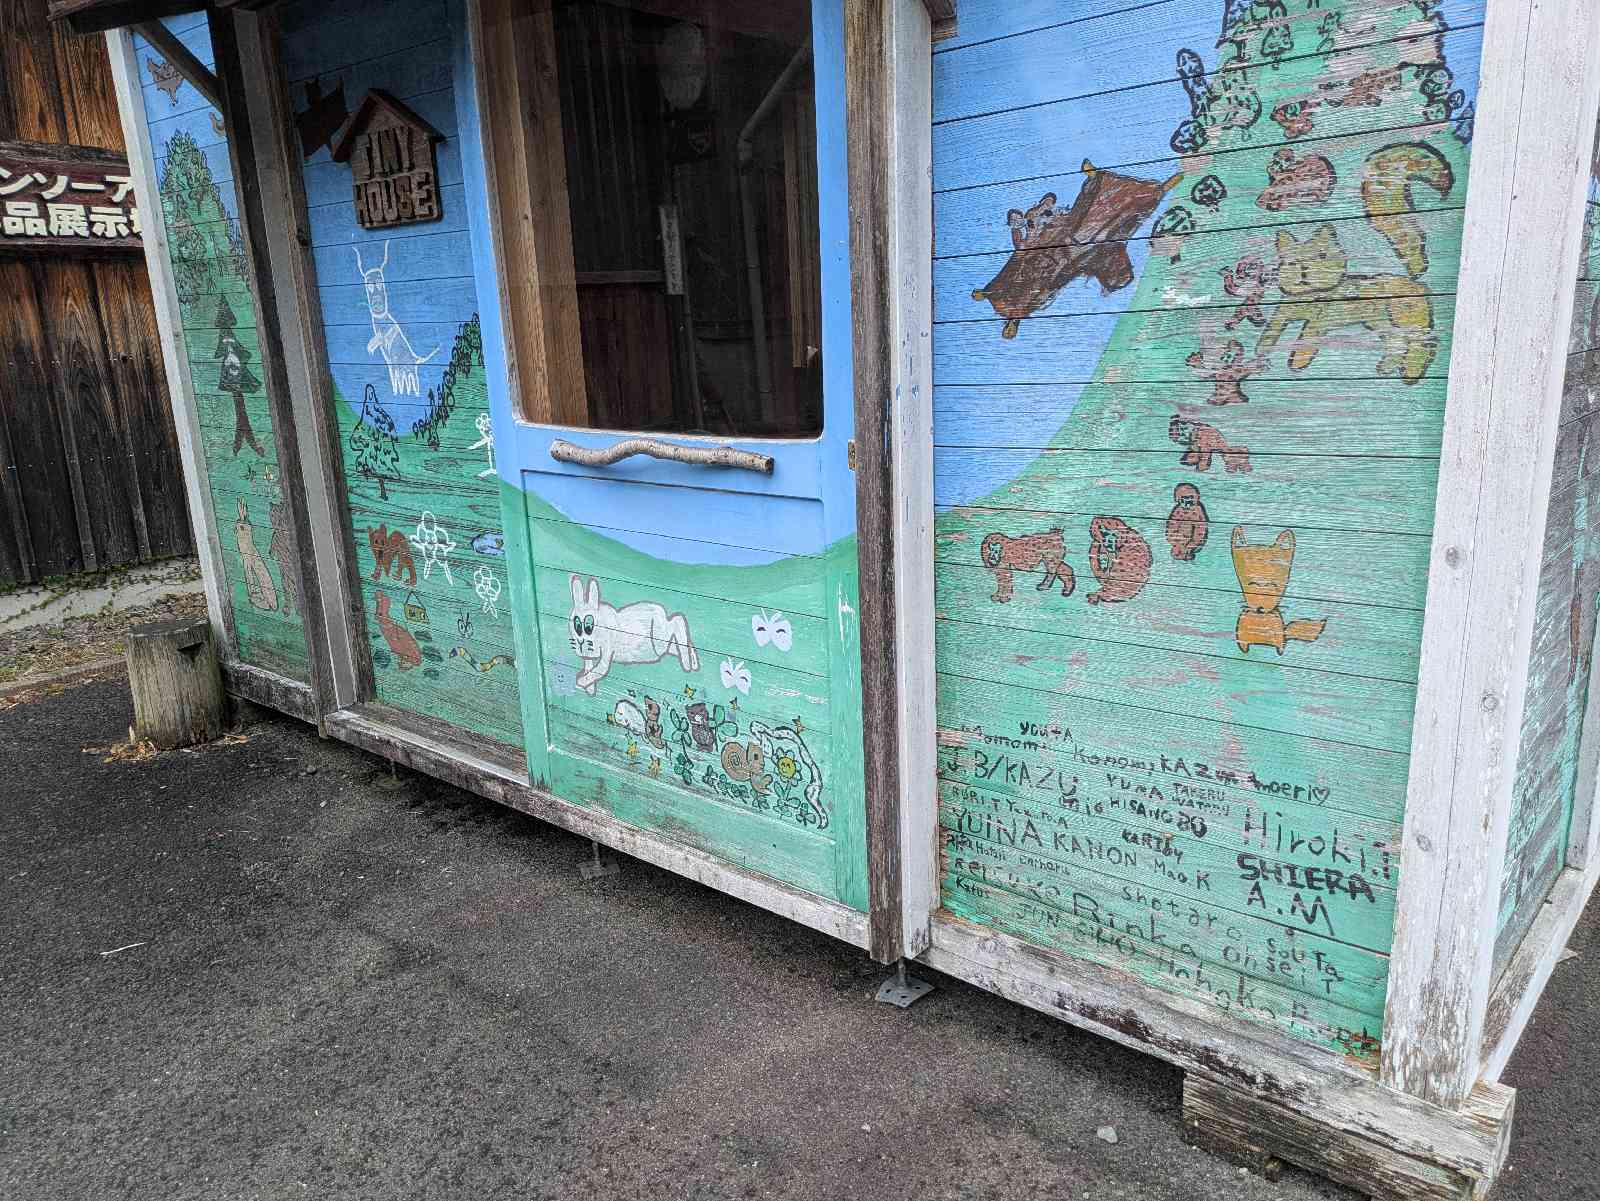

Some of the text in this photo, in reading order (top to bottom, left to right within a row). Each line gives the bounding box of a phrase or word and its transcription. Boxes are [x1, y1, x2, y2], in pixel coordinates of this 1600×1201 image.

[366, 128, 416, 178] TINY
[2, 201, 142, 238] 品展示
[355, 172, 436, 224] HOUSE
[953, 806, 1043, 850] YUINA
[1053, 831, 1137, 869] KANON
